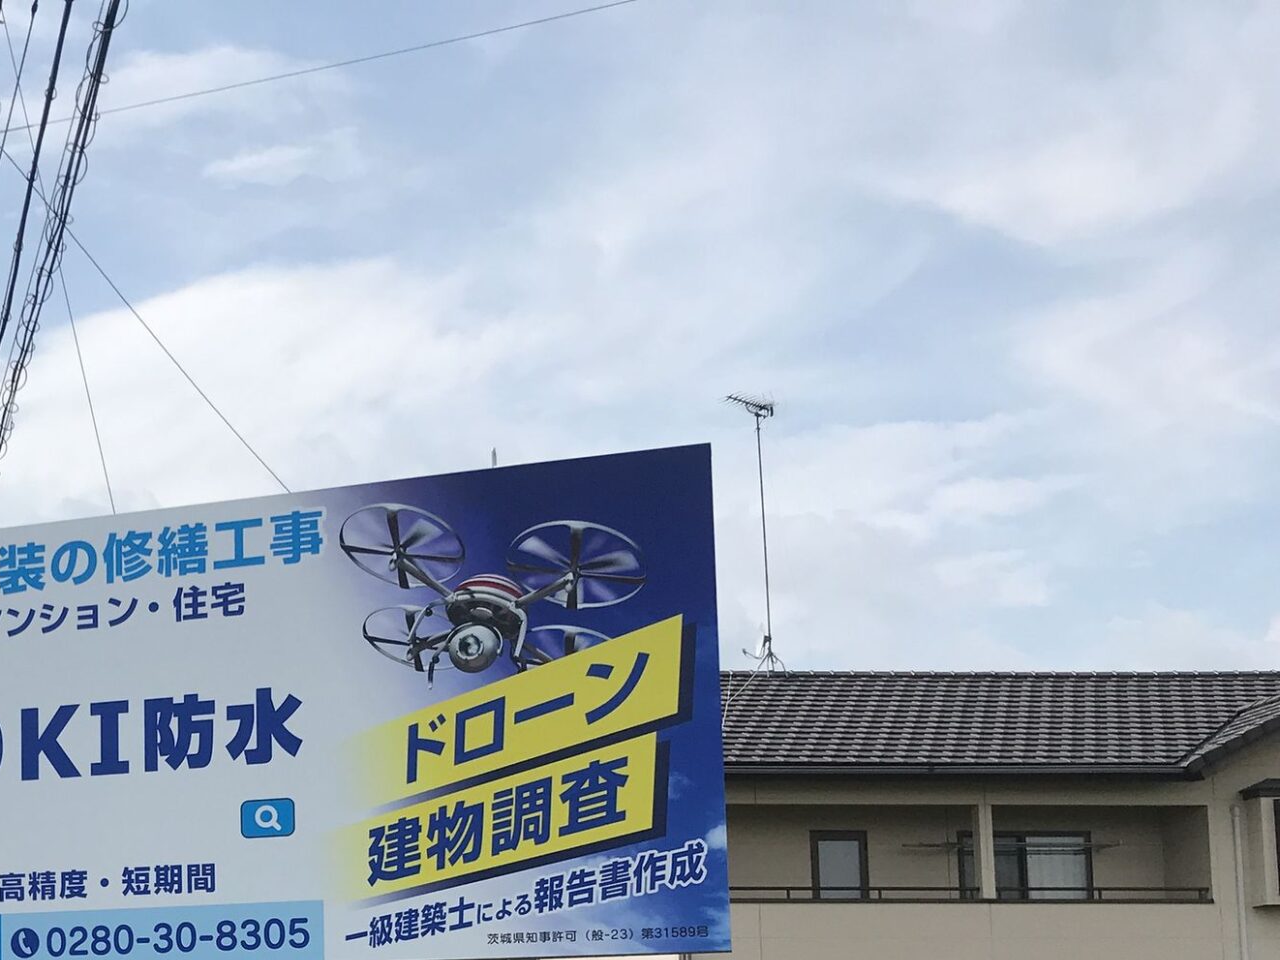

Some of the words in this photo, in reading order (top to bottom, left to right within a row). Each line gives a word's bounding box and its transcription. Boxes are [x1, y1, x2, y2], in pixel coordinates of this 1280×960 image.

[406, 651, 651, 783] ドローン
[367, 755, 631, 887] 建物調査
[46, 917, 310, 956] 0280-30-8305
[344, 839, 709, 949] 一級建築士による報告書作成
